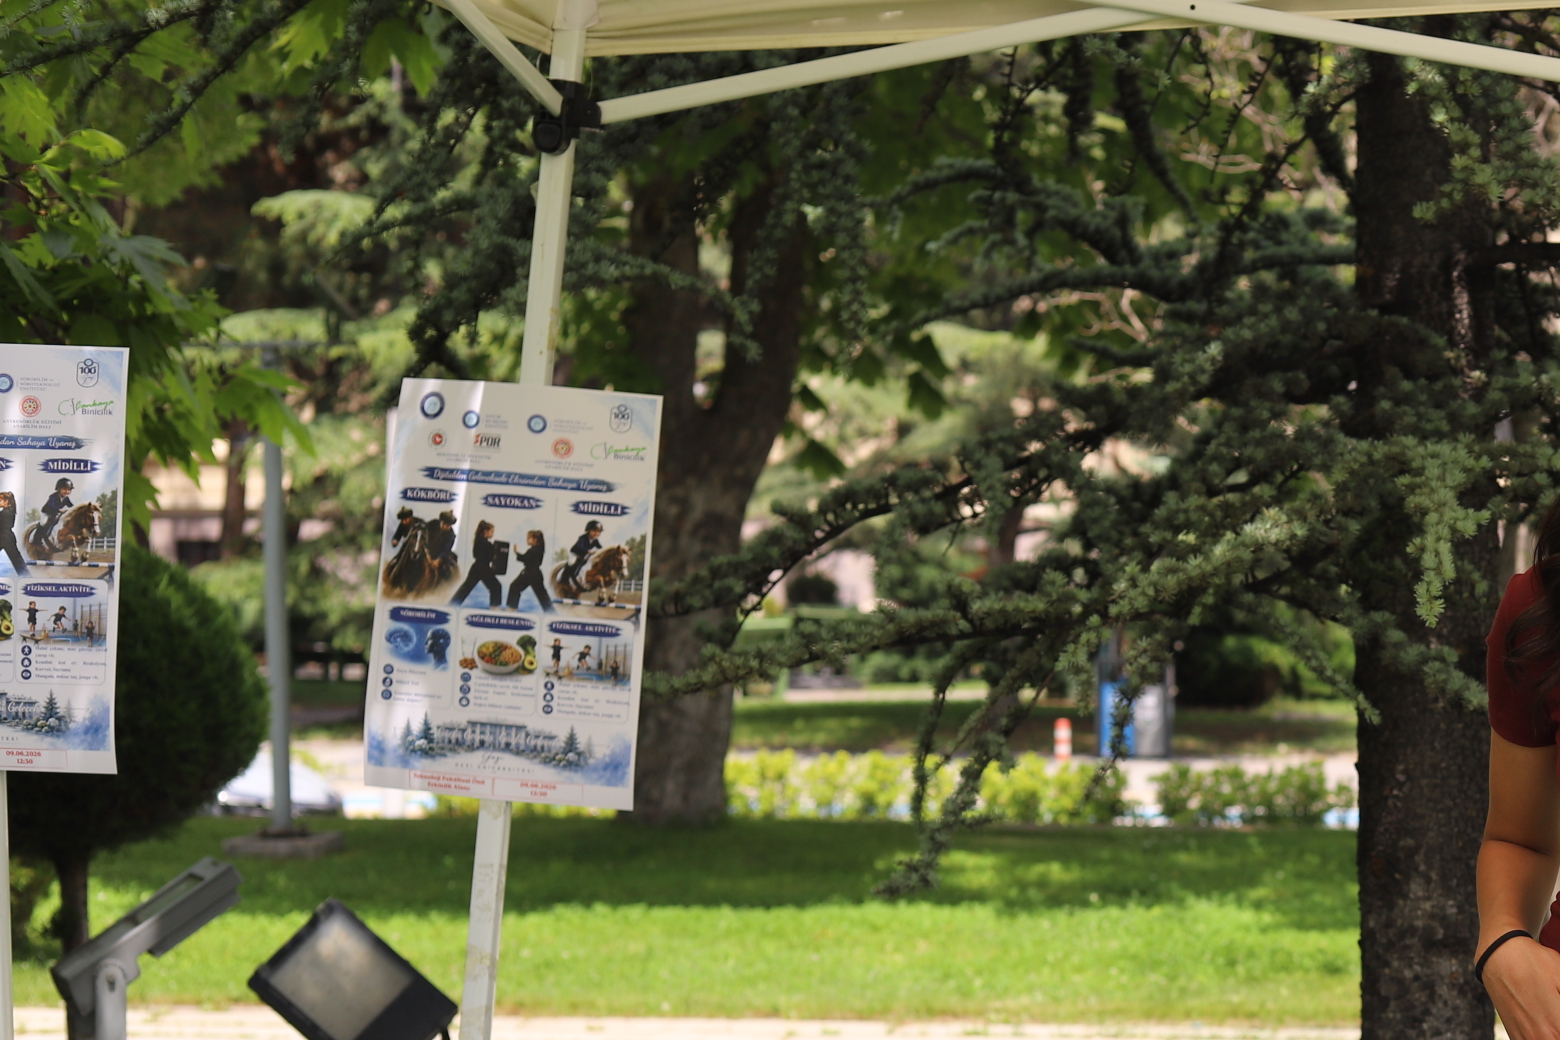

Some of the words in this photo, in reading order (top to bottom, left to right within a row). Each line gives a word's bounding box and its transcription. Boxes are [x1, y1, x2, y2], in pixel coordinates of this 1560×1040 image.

[81, 408, 114, 416] Binicilik
[47, 460, 91, 471] MİDİLLİ
[487, 496, 537, 508] SAYOKAN
[578, 502, 623, 515] MİDİLLİ
[27, 585, 57, 593] FİZİKSEL
[59, 585, 91, 593] AKTİVİTE
